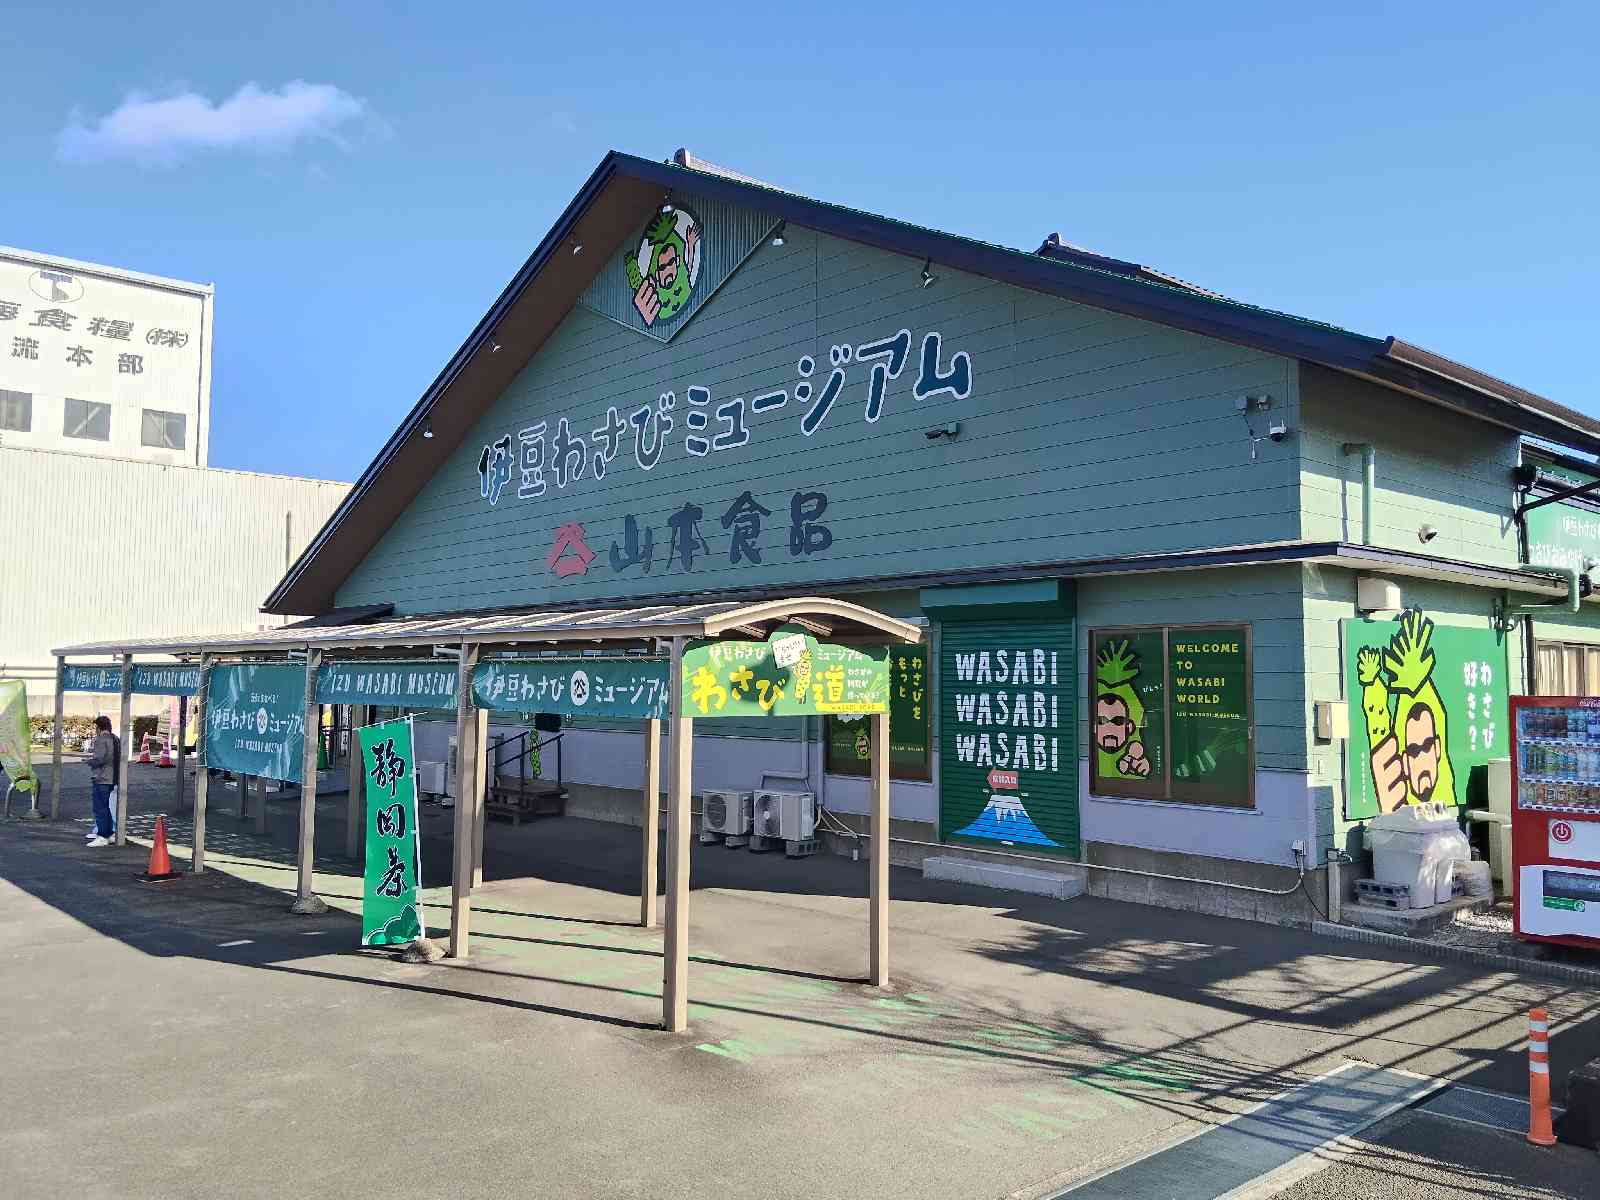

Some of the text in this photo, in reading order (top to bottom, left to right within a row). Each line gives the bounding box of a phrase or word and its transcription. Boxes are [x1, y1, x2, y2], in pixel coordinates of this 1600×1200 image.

[478, 328, 973, 506] 伊豆わさびミュージアム
[609, 490, 833, 573] 山本食品
[955, 648, 1058, 685] WASABI
[1176, 643, 1239, 653] WELCOME
[1176, 660, 1193, 670] TO
[331, 671, 456, 695] IZU WASABI MUSEUM
[485, 673, 669, 705] 伊豆わさび ミュージアム
[691, 665, 786, 714] わさび
[898, 656, 908, 698] もっと
[912, 656, 923, 720] わさびを
[1176, 676, 1226, 687] WASABI
[955, 690, 1058, 728] WASABI
[1176, 694, 1220, 704] WORLD
[1480, 660, 1496, 749] わさび
[211, 708, 255, 730] 伊豆わさび
[955, 732, 1059, 772] WASABI
[369, 738, 408, 898] 静岡茶
